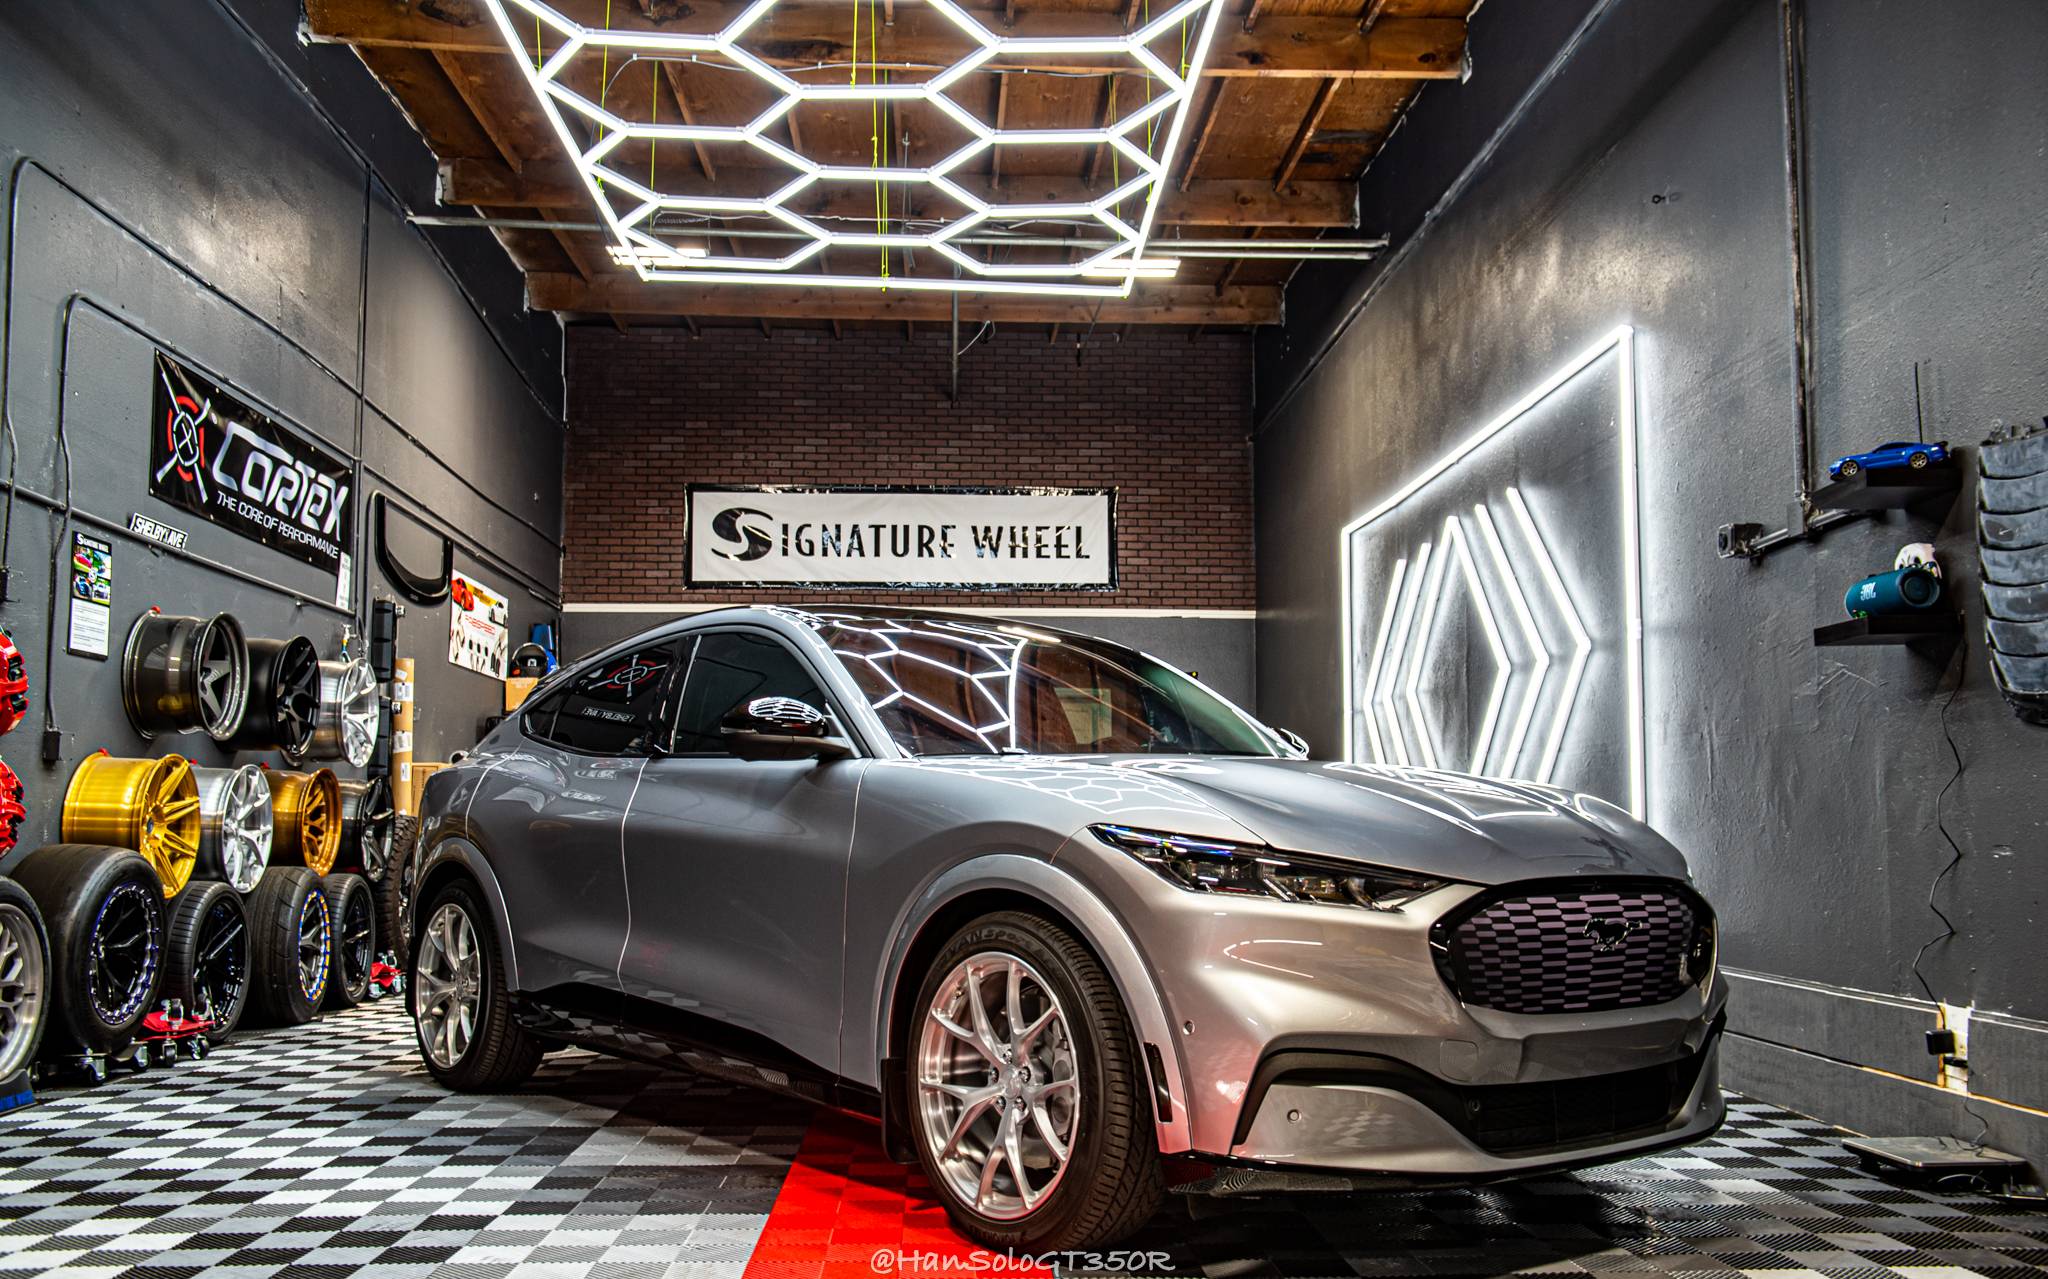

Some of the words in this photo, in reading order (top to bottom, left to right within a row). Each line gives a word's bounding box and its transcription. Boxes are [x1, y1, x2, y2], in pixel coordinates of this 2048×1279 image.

[134, 517, 166, 542] SHELBY
[167, 530, 185, 548] AVE
[217, 490, 238, 512] THE
[238, 501, 264, 525] CORE
[263, 514, 280, 530] OF
[278, 520, 340, 559] PERFORMANCE
[711, 507, 957, 561] SIGNATURE
[970, 525, 1090, 559] WHEEL
[1860, 581, 1876, 601] JBL
